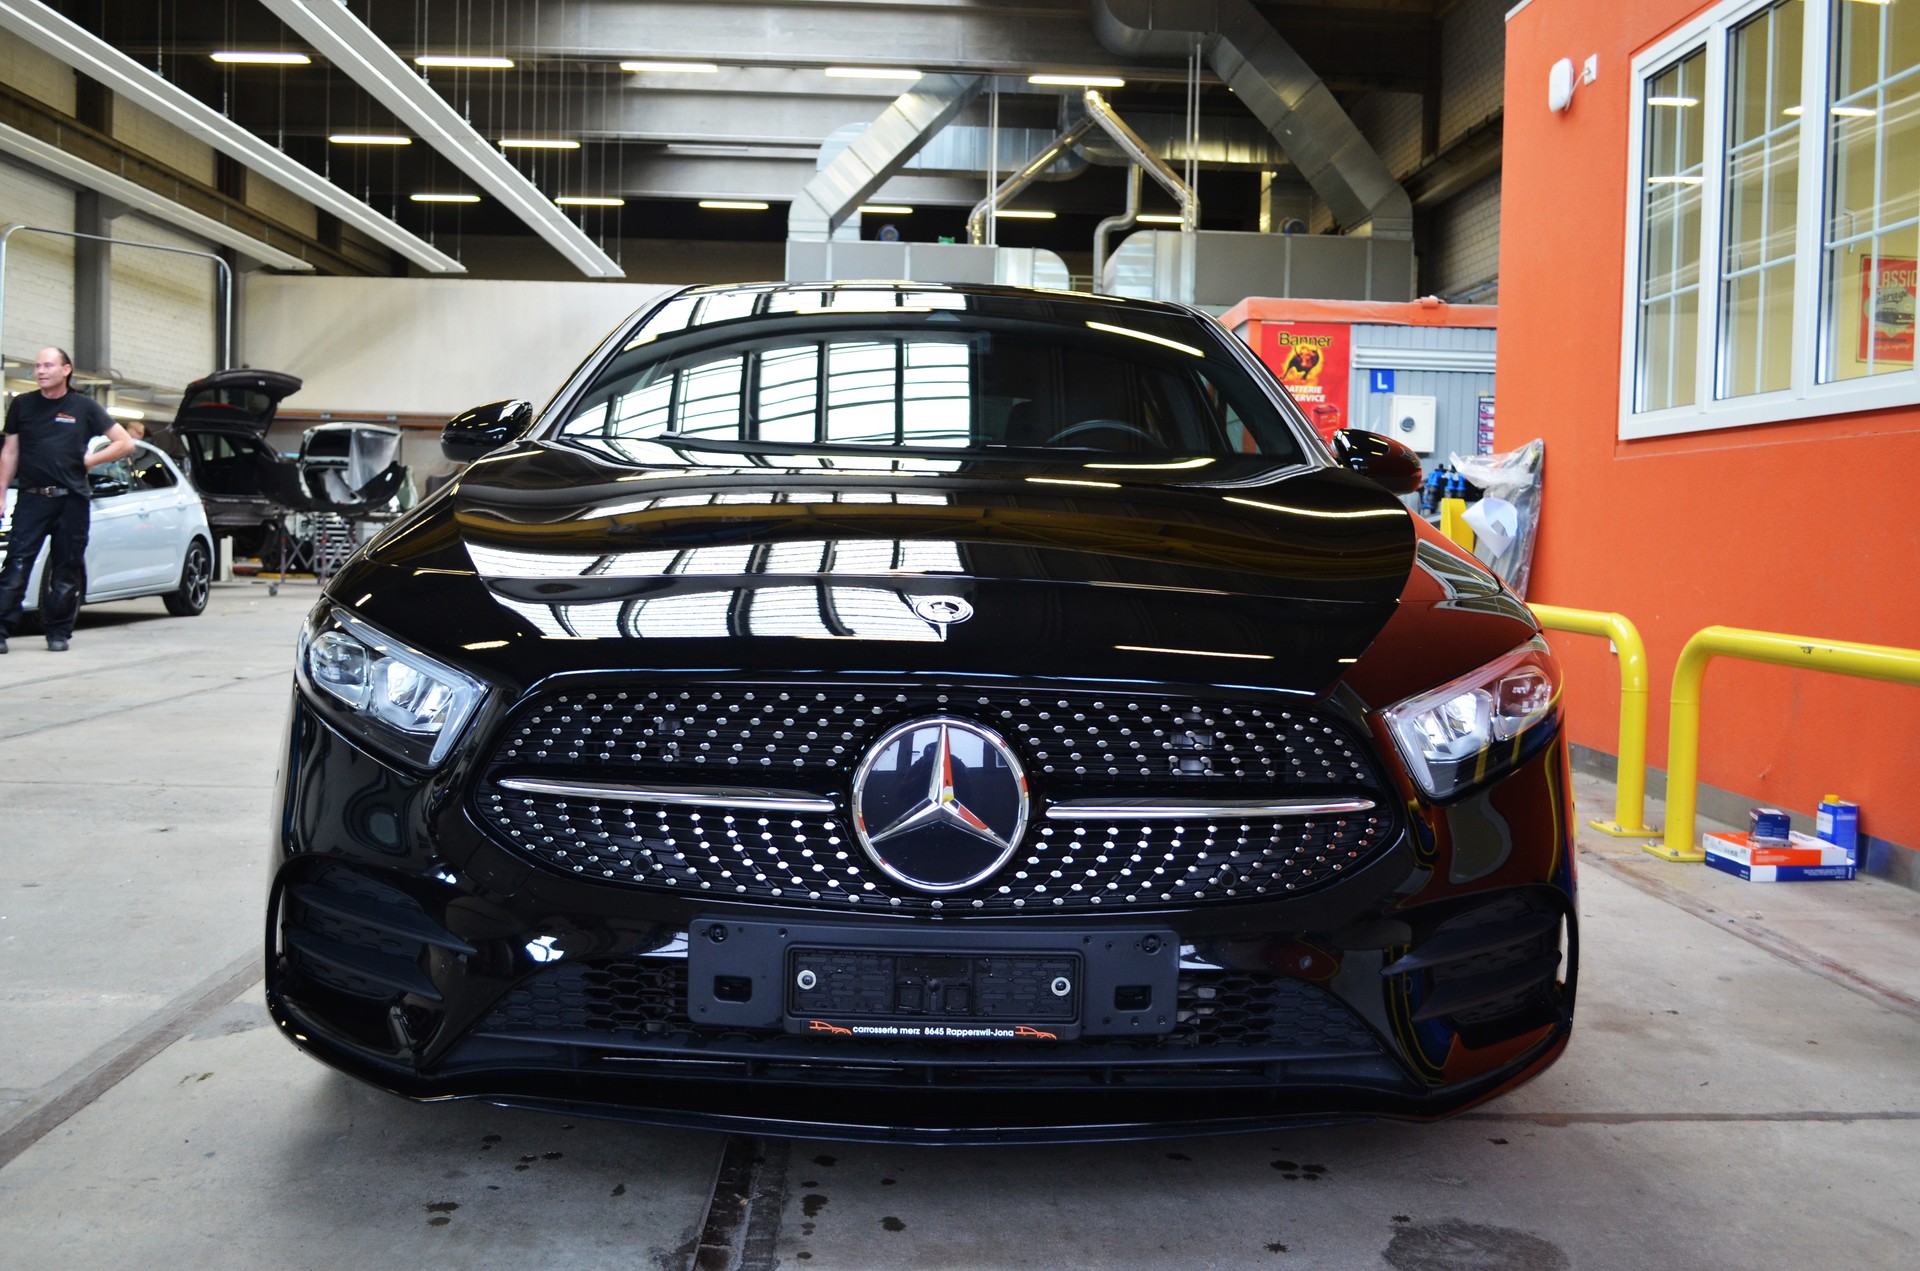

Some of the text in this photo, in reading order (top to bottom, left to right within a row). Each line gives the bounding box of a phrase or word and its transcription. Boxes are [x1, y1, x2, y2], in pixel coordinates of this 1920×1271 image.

[1868, 270, 1917, 288] LASSIC
[1279, 331, 1332, 347] Banner
[1377, 372, 1388, 389] L
[853, 1026, 898, 1034] carrosserie
[924, 1027, 944, 1035] 8645
[946, 1027, 1014, 1037] Rapperswil-Jona
